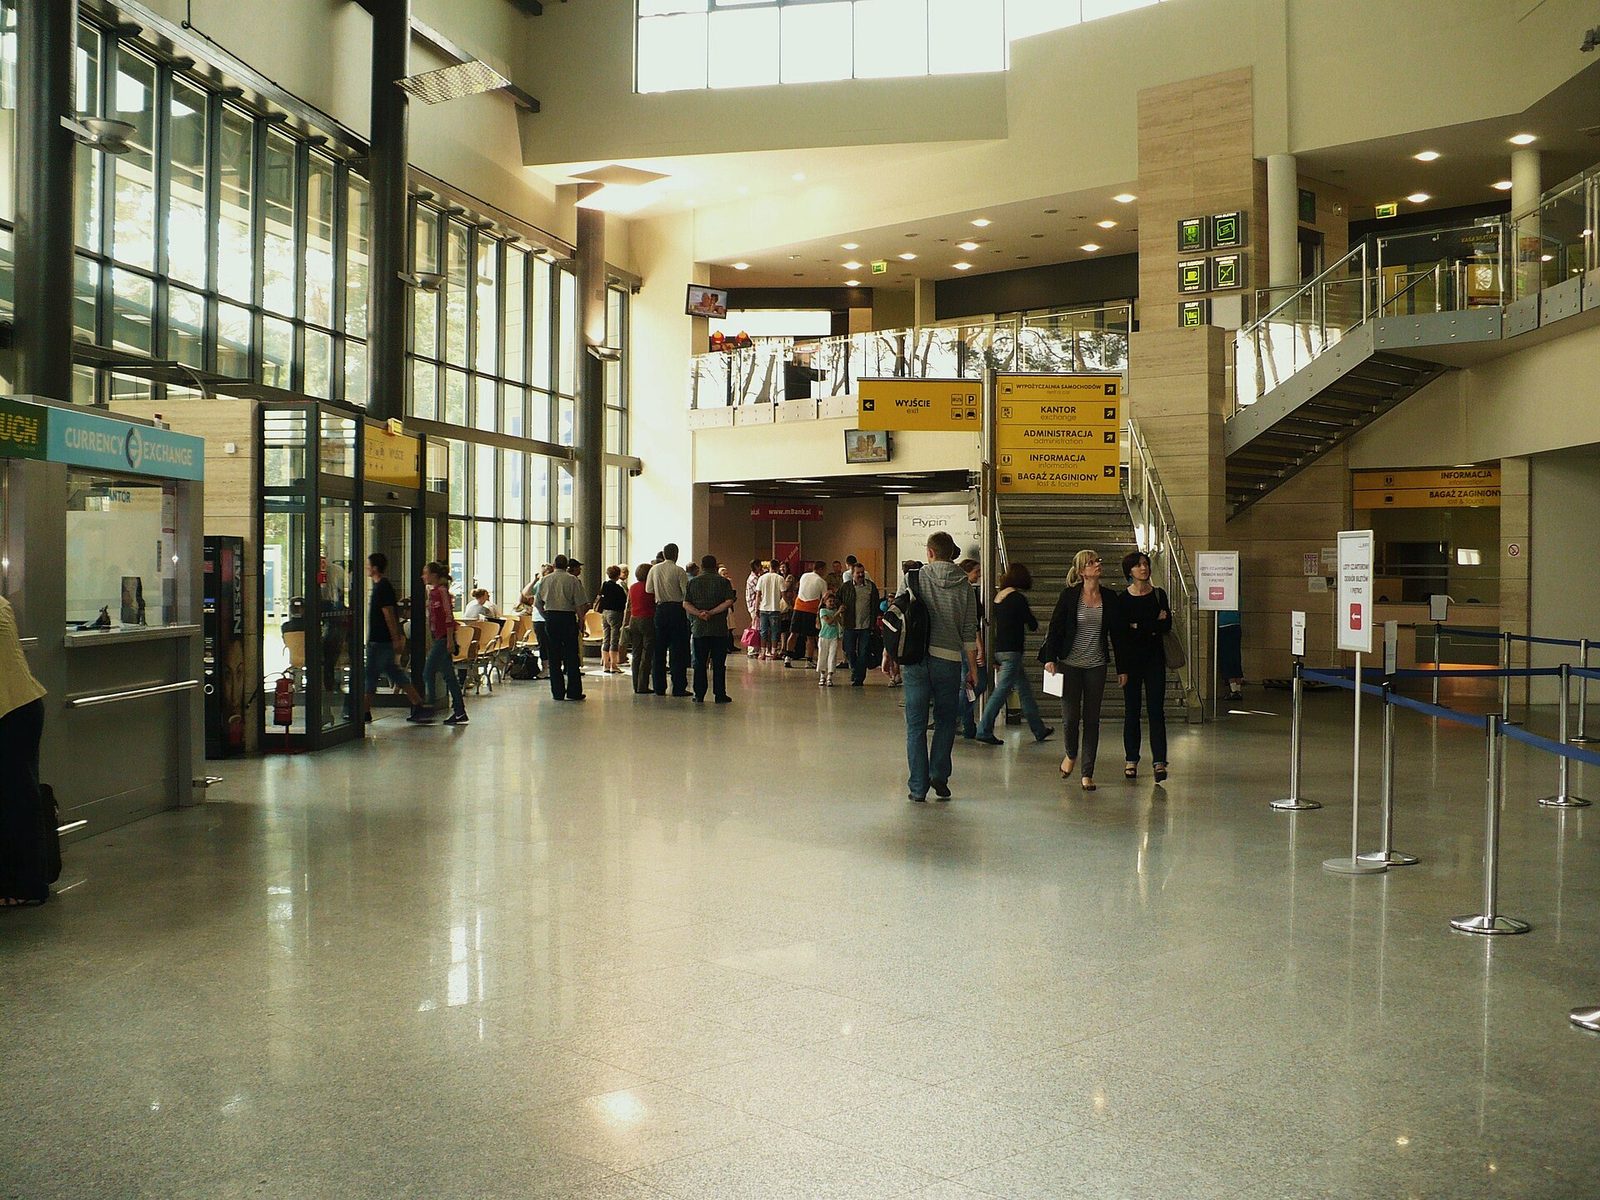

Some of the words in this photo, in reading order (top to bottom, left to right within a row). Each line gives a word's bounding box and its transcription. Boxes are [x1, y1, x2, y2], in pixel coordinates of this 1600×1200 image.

[895, 398, 930, 407] WYJŚCIE
[65, 427, 124, 456] CURRENCY
[144, 442, 192, 466] EXCHANGE
[1018, 471, 1047, 480] BAGAŻ
[1441, 471, 1492, 479] INFORMACJA
[1429, 490, 1456, 498] BAGAŻ
[912, 518, 947, 528] Rypin
